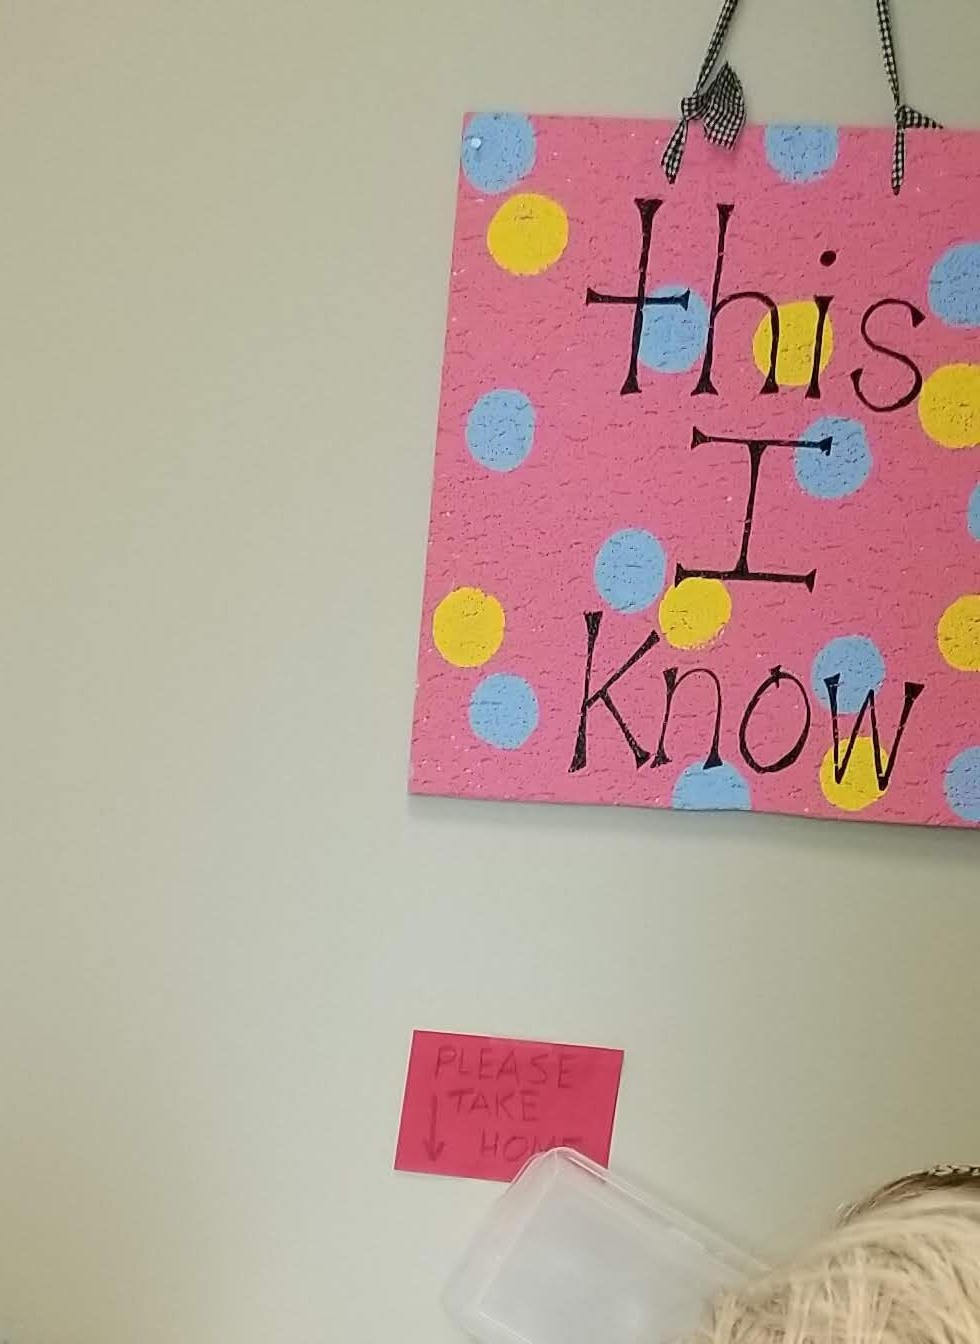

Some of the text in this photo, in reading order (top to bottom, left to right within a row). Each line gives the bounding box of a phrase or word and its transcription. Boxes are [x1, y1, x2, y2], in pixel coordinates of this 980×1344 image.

[585, 198, 926, 413] this
[673, 425, 834, 592] I
[435, 1045, 575, 1089] PLEASE
[447, 1087, 539, 1122] TAKE
